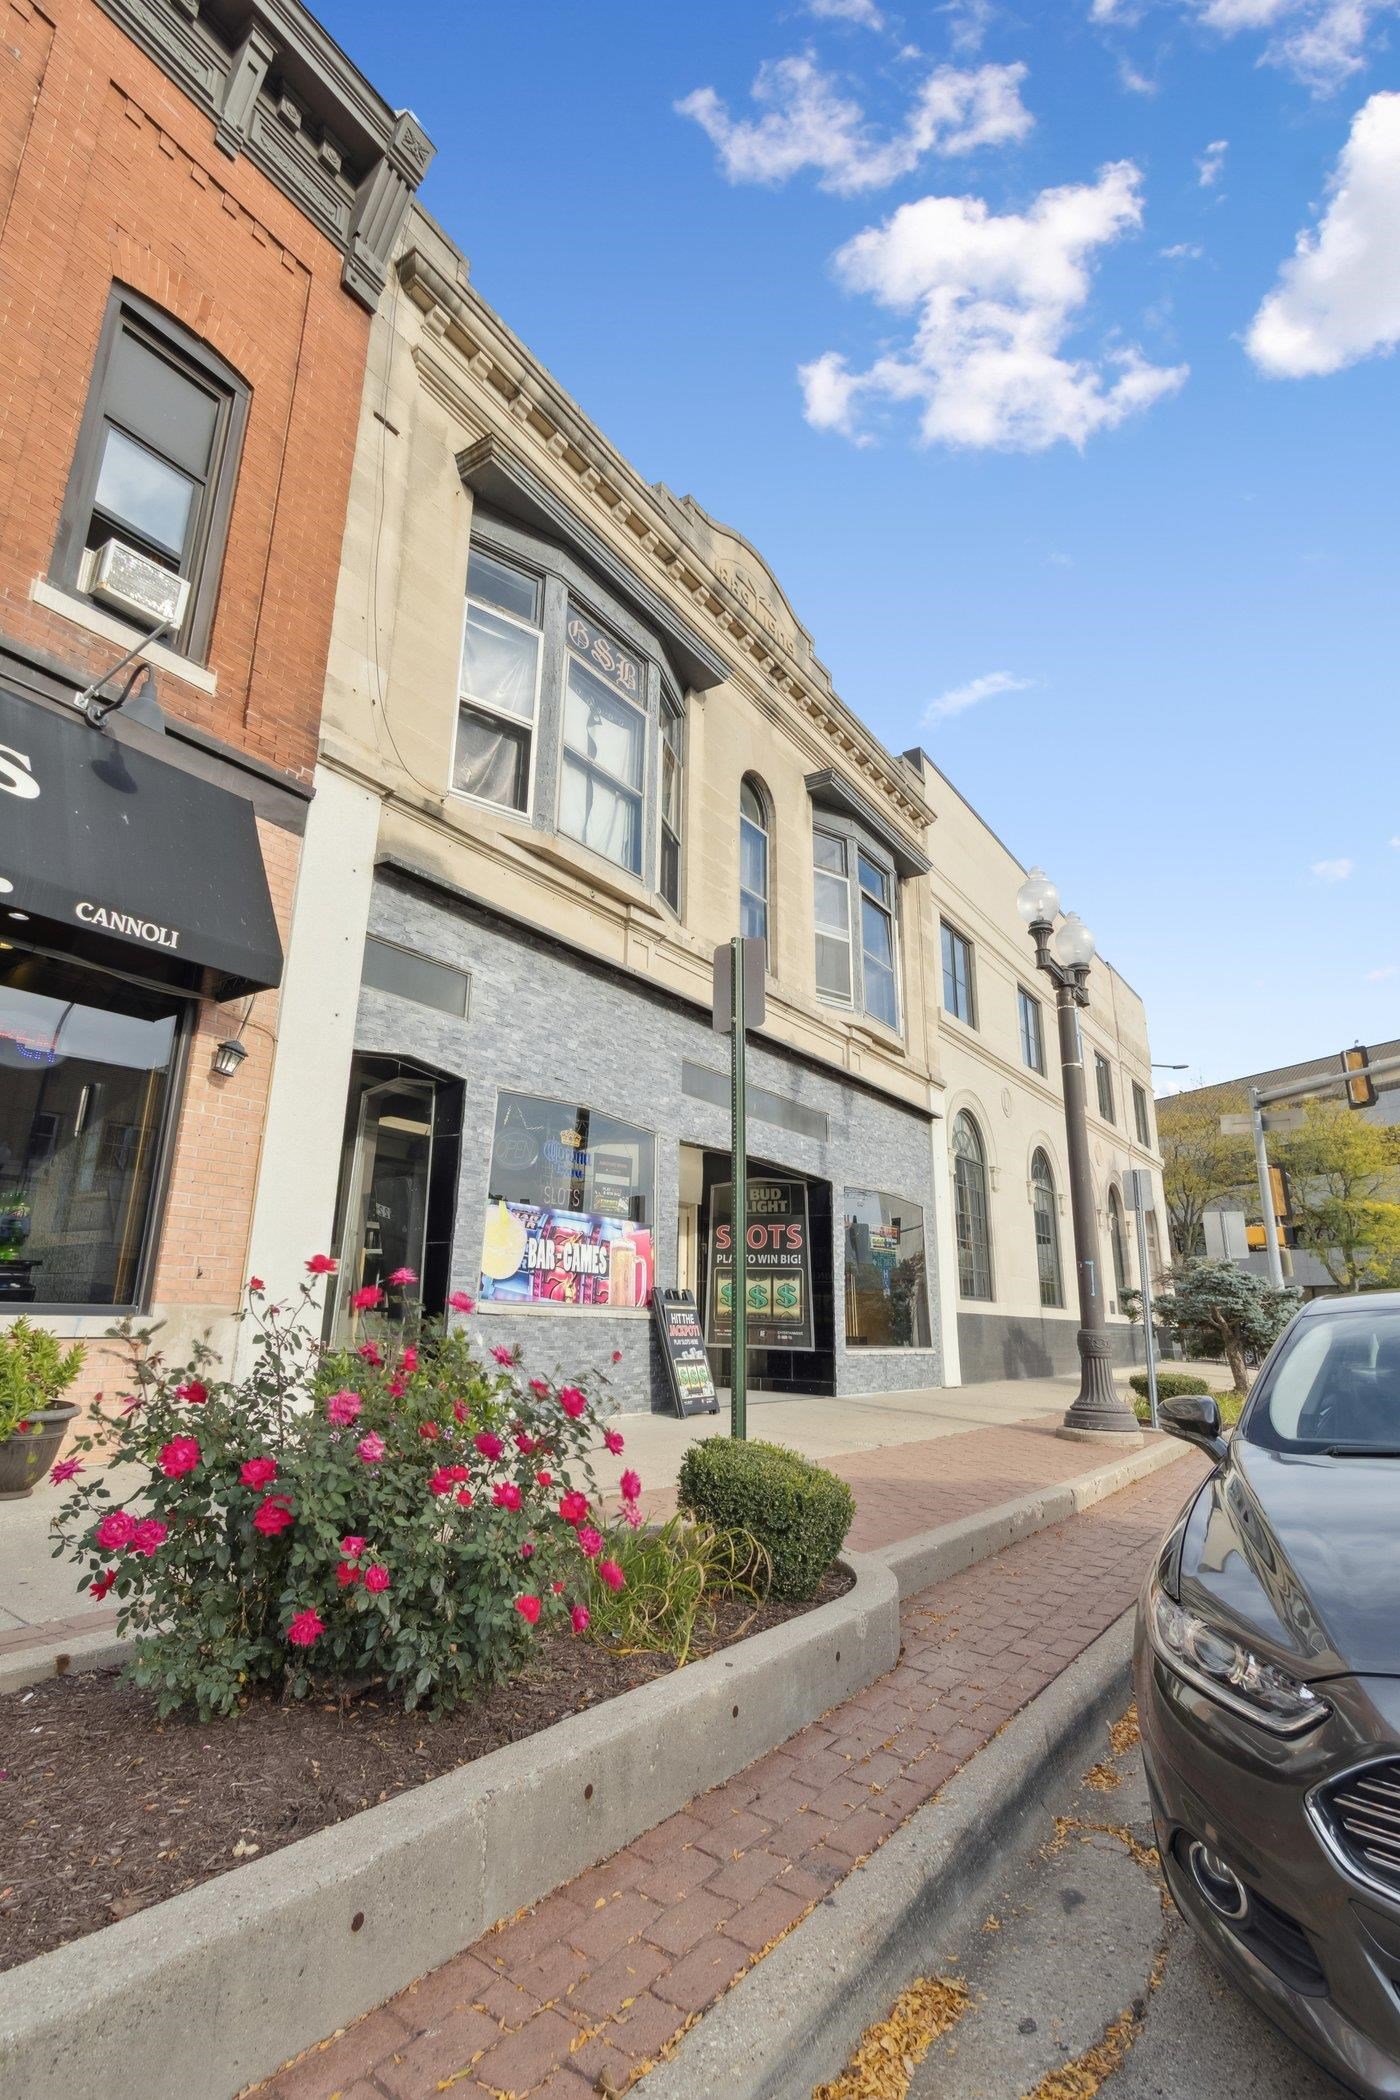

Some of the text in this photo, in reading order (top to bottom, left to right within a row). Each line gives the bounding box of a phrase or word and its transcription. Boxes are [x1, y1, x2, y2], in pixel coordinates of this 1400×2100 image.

[75, 902, 180, 949] CANNOLI
[543, 1186, 581, 1207] SLOTS
[749, 1188, 782, 1201] BUD
[715, 1224, 803, 1250] SOTS
[757, 1254, 778, 1264] WIN
[780, 1254, 802, 1264] BIG!
[670, 1313, 695, 1325] HIT THE
[669, 1325, 700, 1337] JACKPOT!
